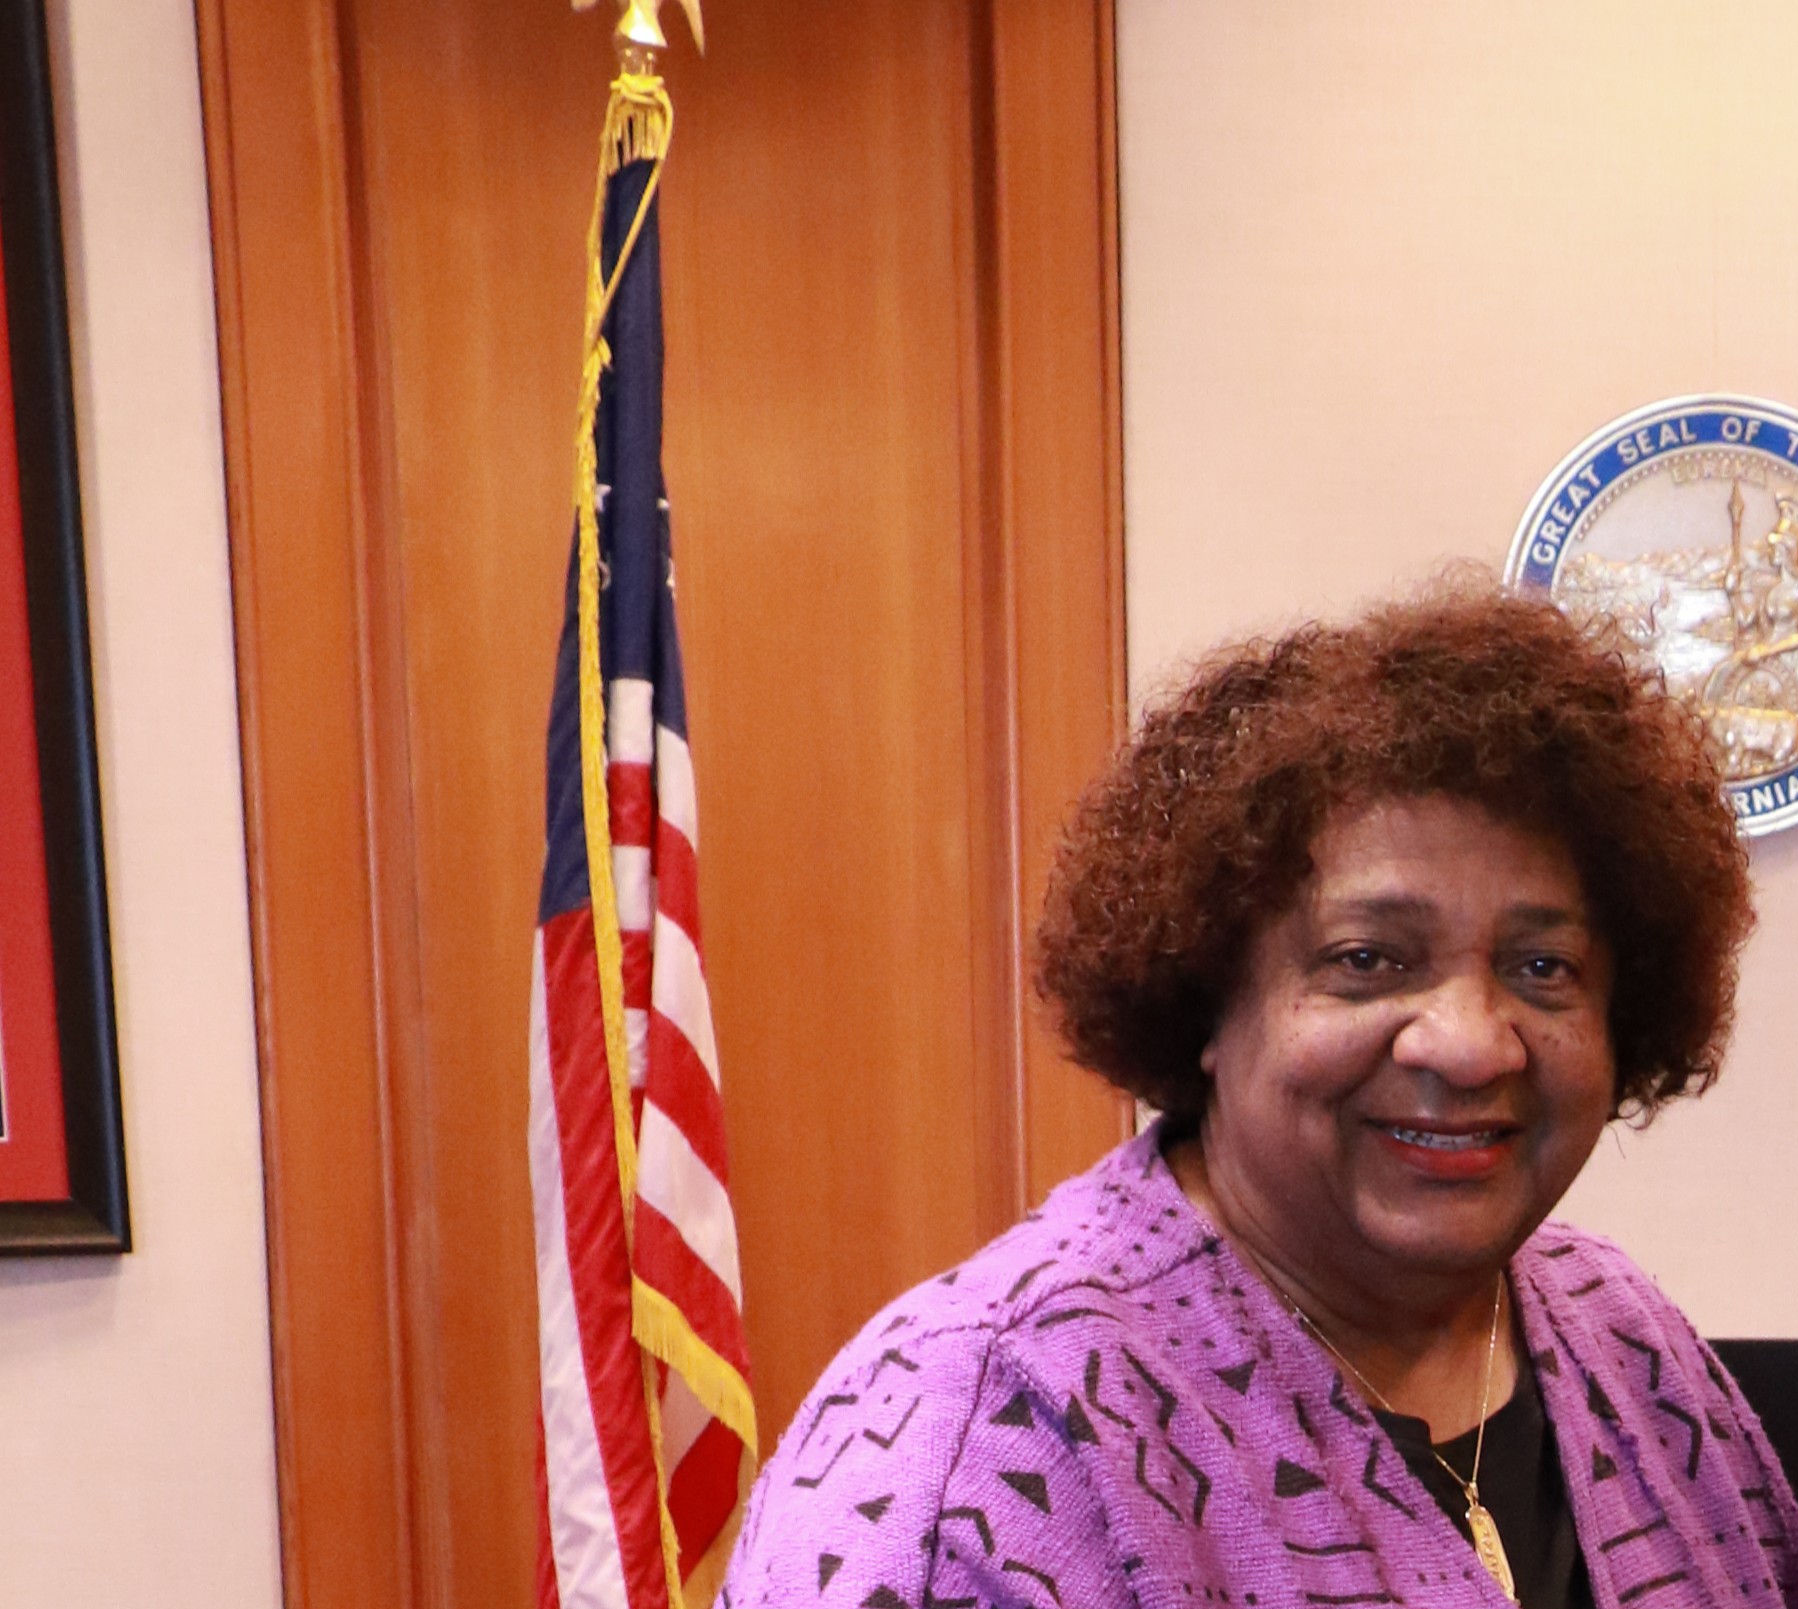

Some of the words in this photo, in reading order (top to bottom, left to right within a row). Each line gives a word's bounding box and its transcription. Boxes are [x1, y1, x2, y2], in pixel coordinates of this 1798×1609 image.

[1531, 464, 1603, 565] GREAT
[1616, 417, 1698, 467] SEAL
[1721, 417, 1763, 443] OF
